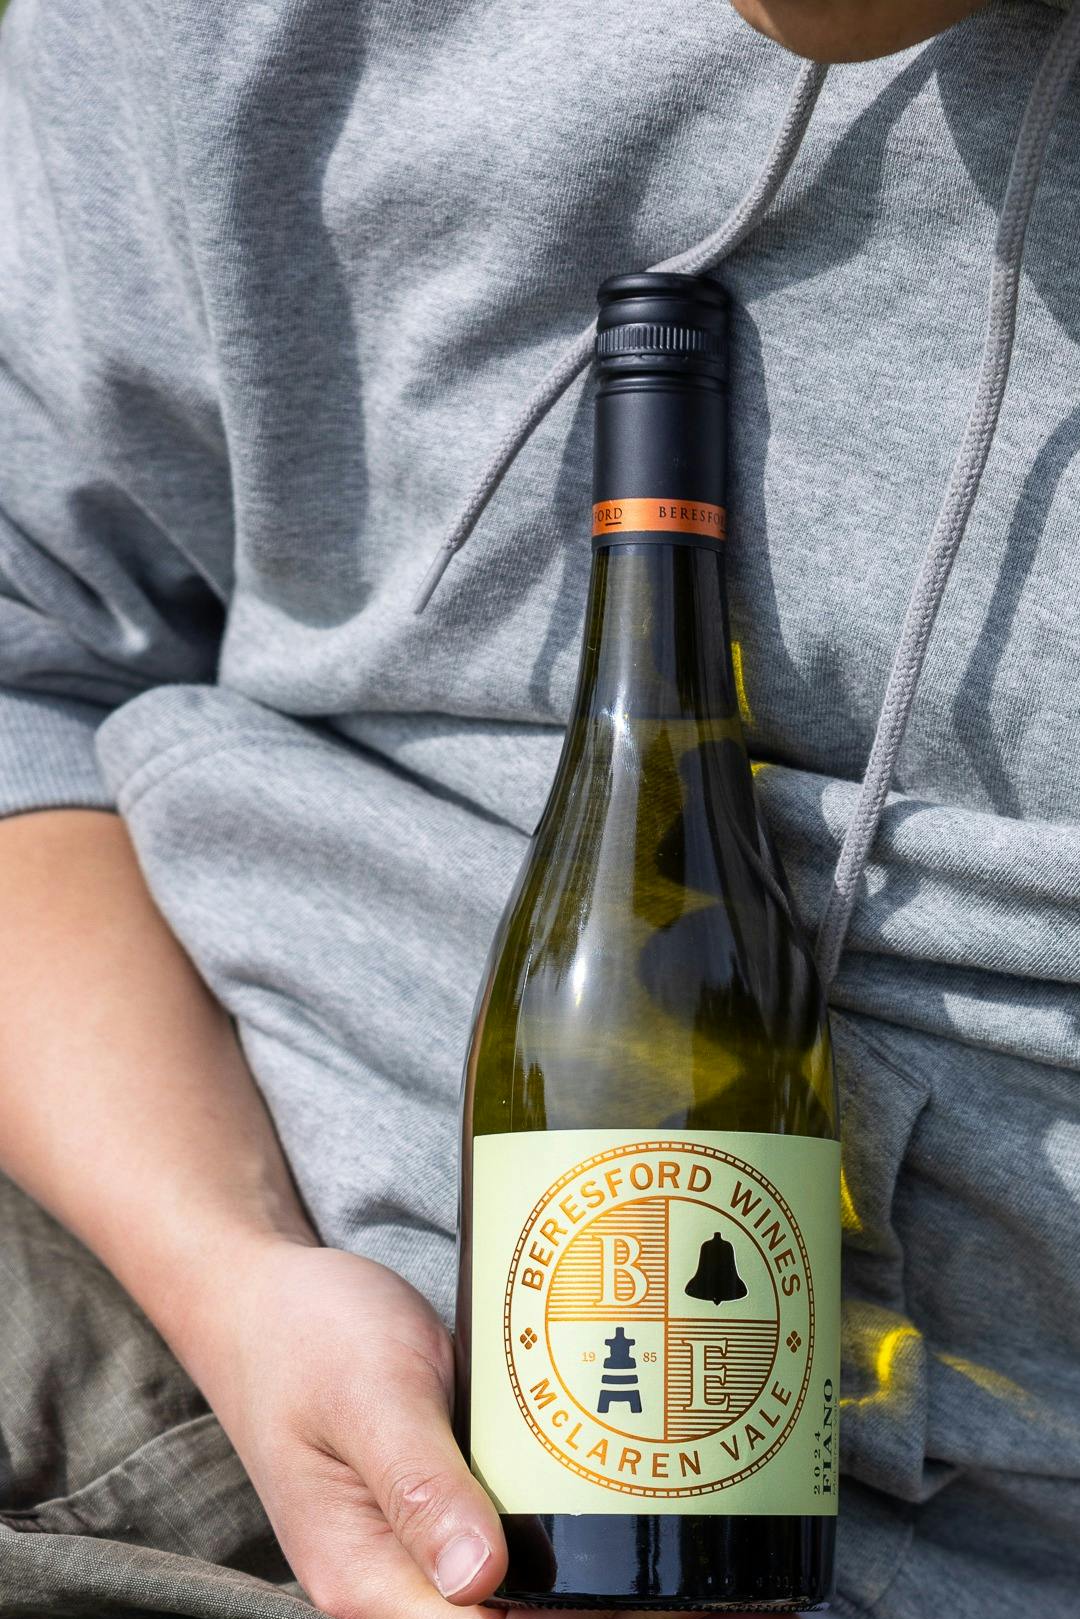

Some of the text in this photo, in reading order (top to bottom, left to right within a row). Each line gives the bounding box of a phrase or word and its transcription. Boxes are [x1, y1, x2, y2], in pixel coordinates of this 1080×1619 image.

[522, 1160, 801, 1297] BERESFORD WINES
[593, 1233, 649, 1307] B
[582, 1351, 658, 1363] 19 85
[681, 1338, 730, 1413] E
[529, 1376, 702, 1479] McLAREN
[720, 1380, 793, 1463] VALE
[823, 1378, 833, 1496] FIANO
